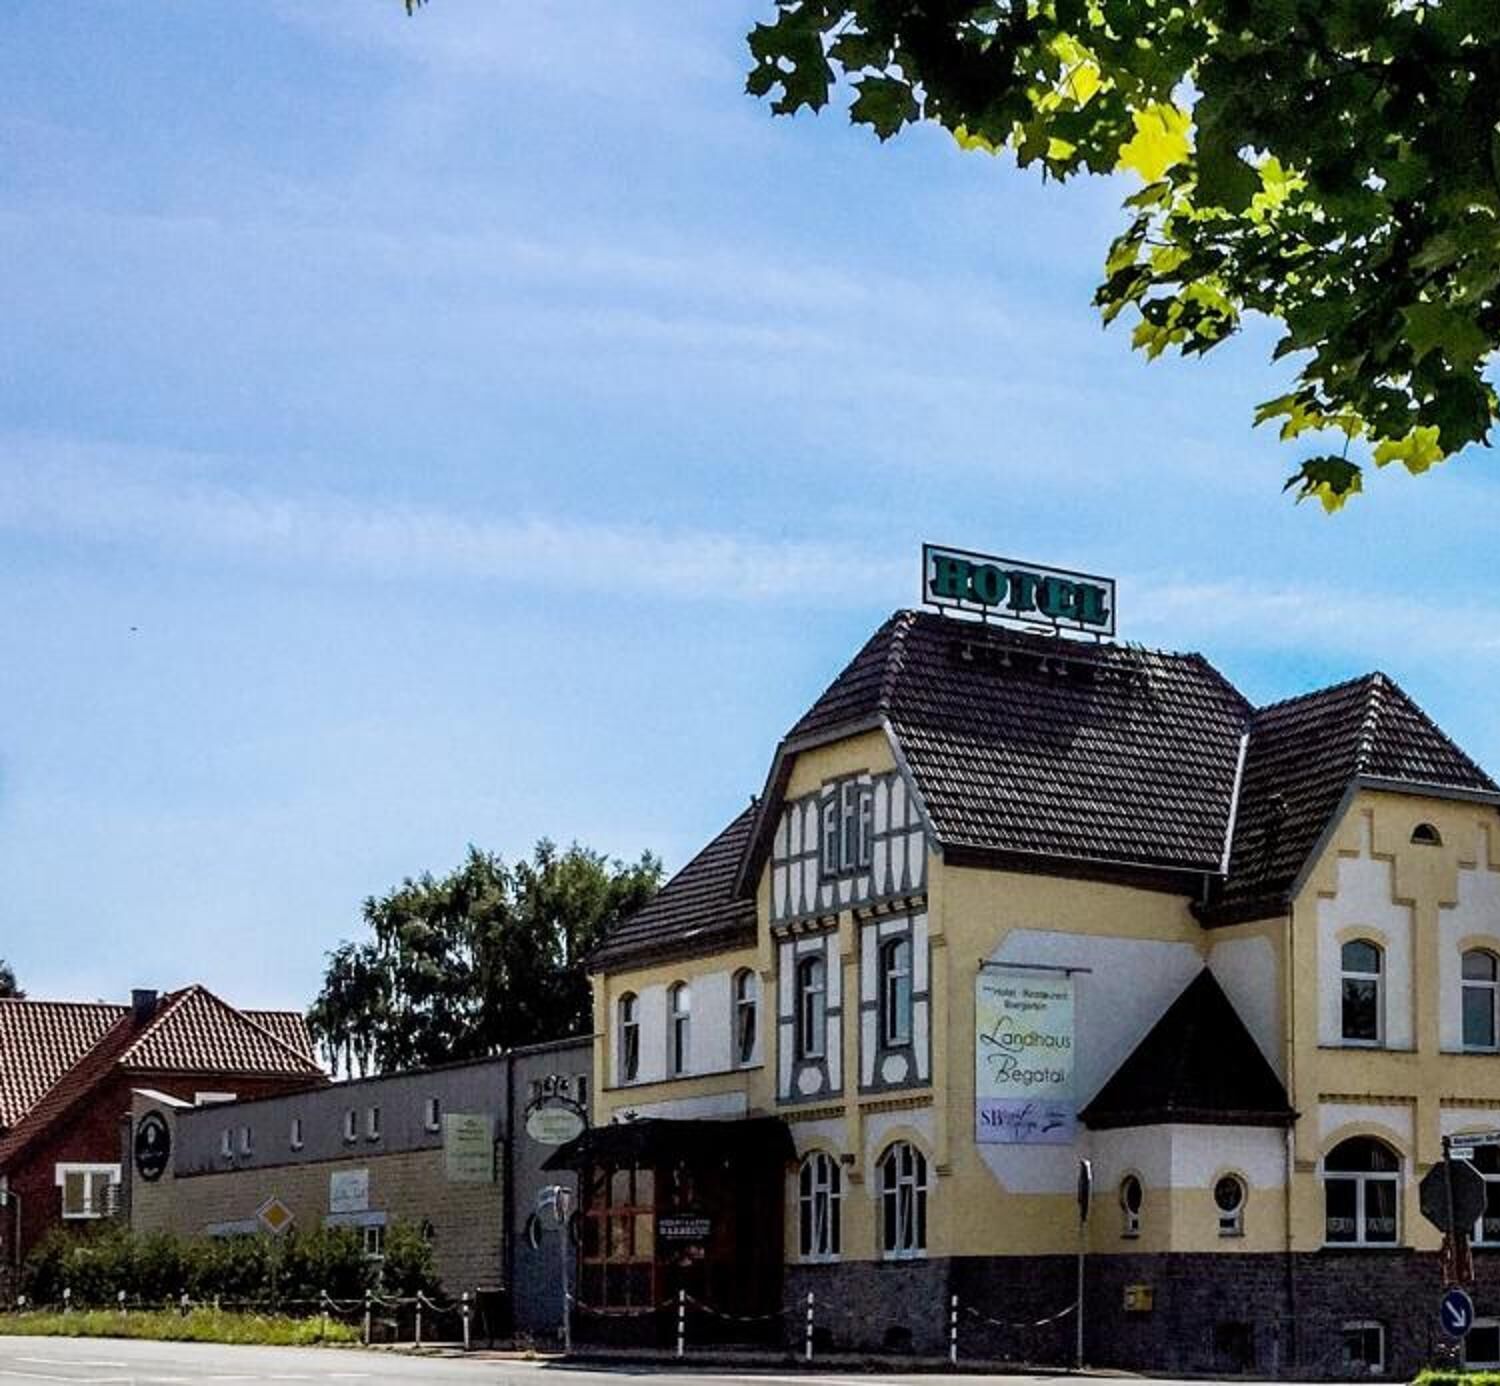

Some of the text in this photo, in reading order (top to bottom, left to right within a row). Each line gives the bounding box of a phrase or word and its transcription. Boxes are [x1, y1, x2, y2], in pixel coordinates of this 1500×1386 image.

[929, 555, 1110, 626] HOTEL
[979, 1015, 1072, 1053] Landhaus
[986, 1053, 1066, 1086] Begatal
